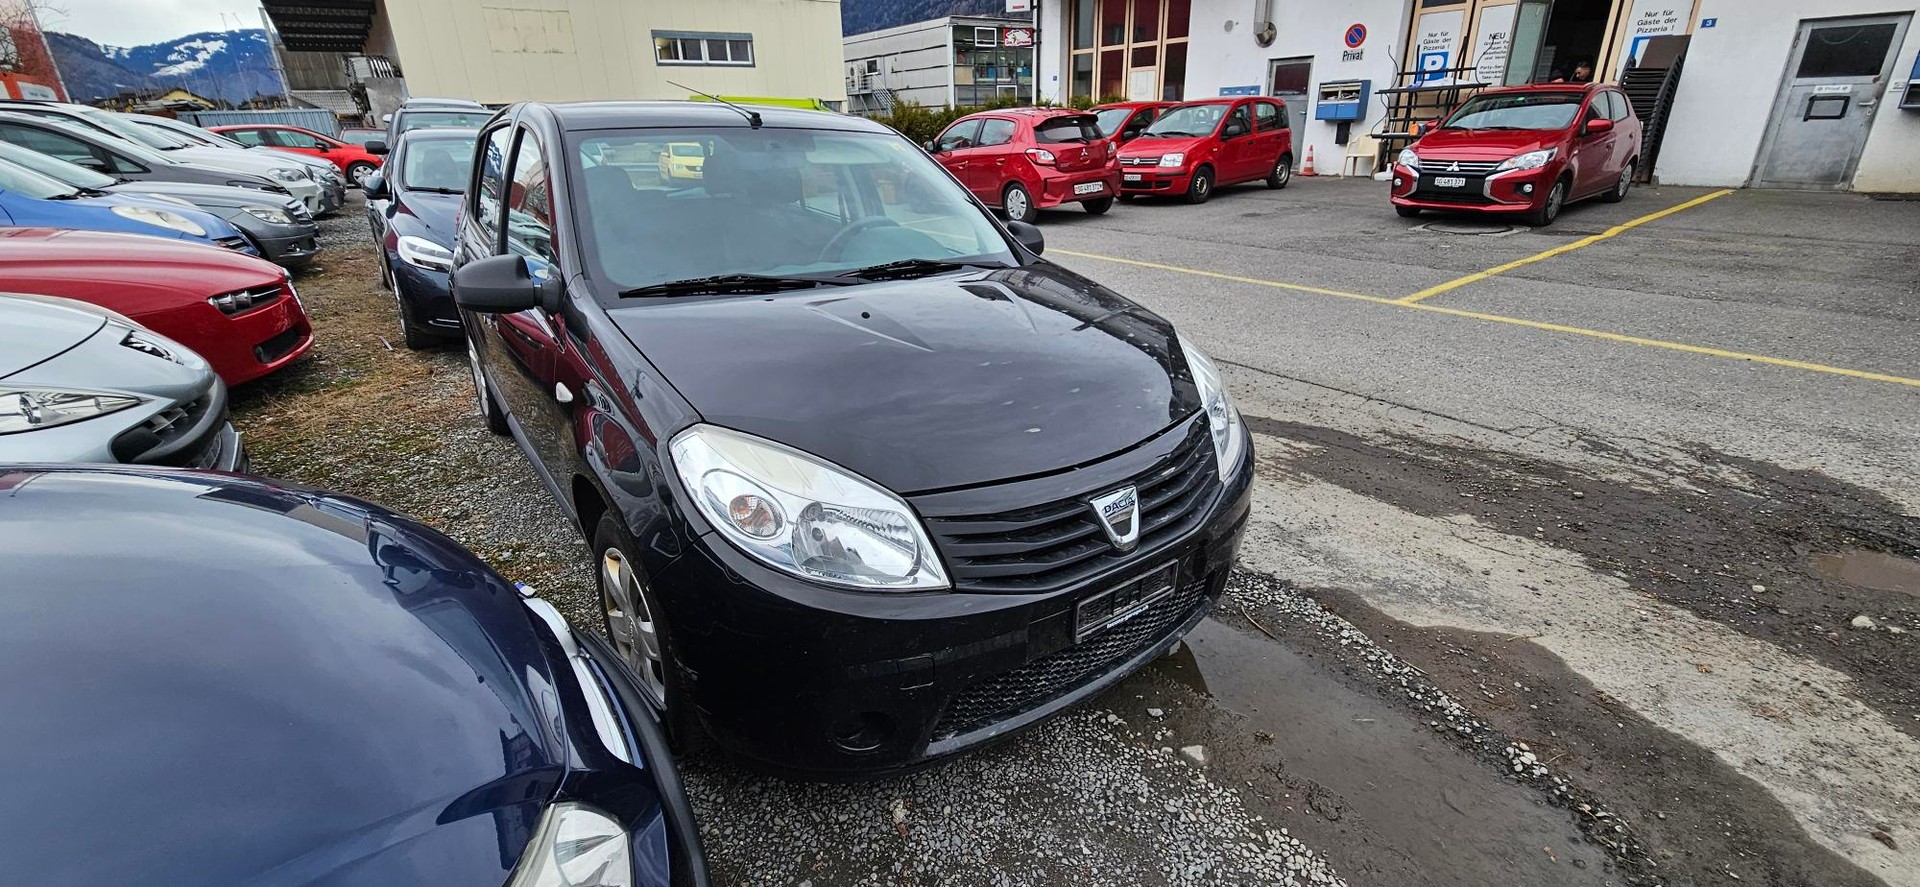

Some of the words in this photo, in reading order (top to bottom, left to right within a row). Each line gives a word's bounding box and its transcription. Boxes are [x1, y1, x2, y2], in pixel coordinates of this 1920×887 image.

[1636, 26, 1668, 34] Pizzeria
[1489, 32, 1506, 40] NEU
[1342, 49, 1364, 61] Privat
[1103, 497, 1135, 514] DACIA
